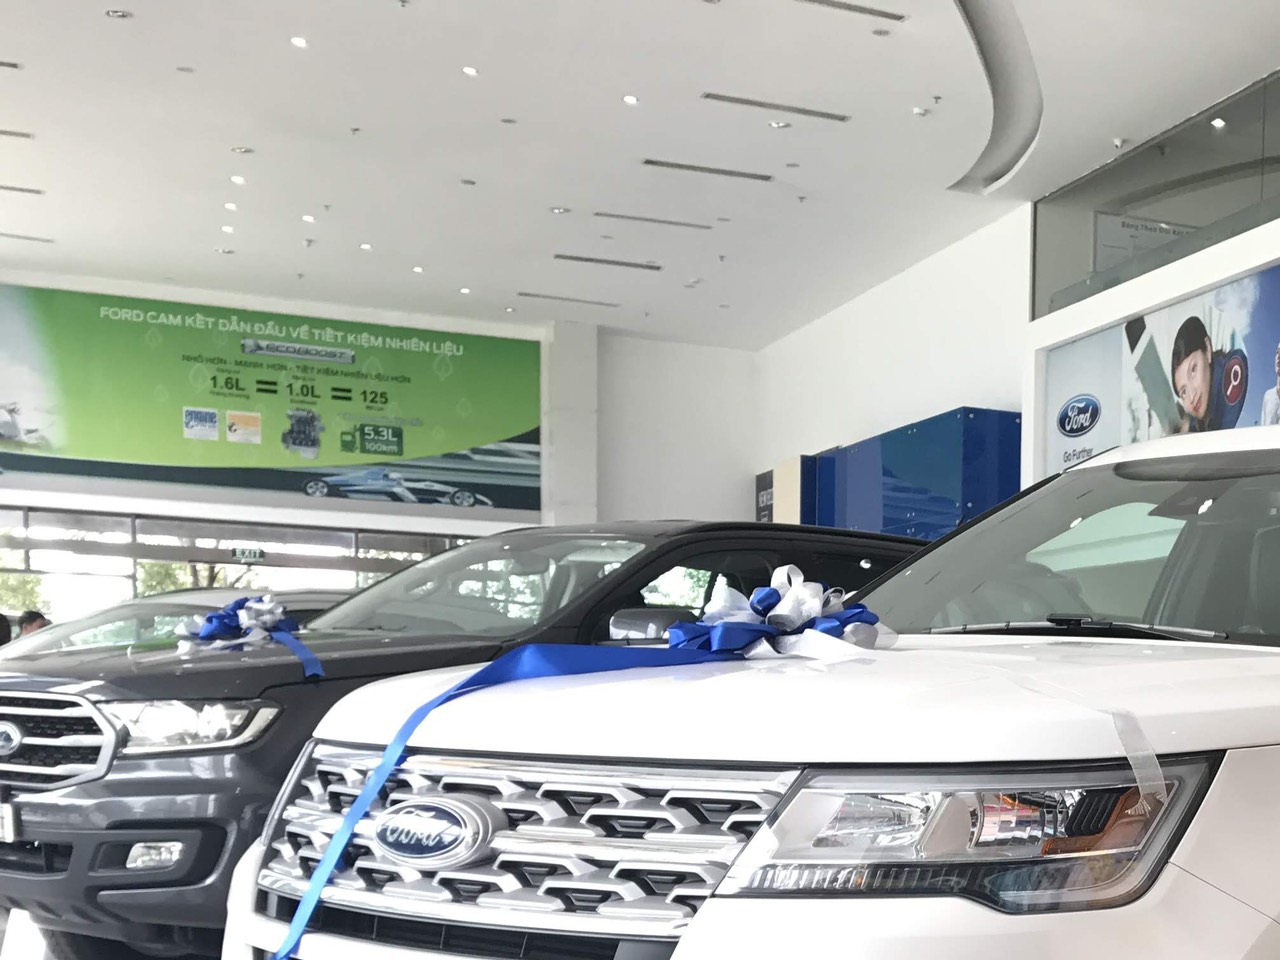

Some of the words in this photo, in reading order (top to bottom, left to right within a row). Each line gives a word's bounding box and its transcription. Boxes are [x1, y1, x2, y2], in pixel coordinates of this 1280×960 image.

[99, 306, 144, 322] FORD
[146, 311, 182, 327] CAM
[185, 312, 215, 329] KẾT
[218, 315, 251, 334] DẪN
[347, 331, 383, 349] KIỆM
[385, 337, 430, 353] NHIÊN
[432, 340, 464, 357] LIỆU
[210, 375, 246, 391] 1.6L
[286, 383, 321, 399] 1.0L
[360, 390, 388, 405] 125
[1064, 402, 1094, 431] Ford
[364, 426, 398, 441] 5.3L
[1063, 451, 1072, 463] Go
[1072, 447, 1094, 461] Further
[235, 548, 262, 558] EXIT
